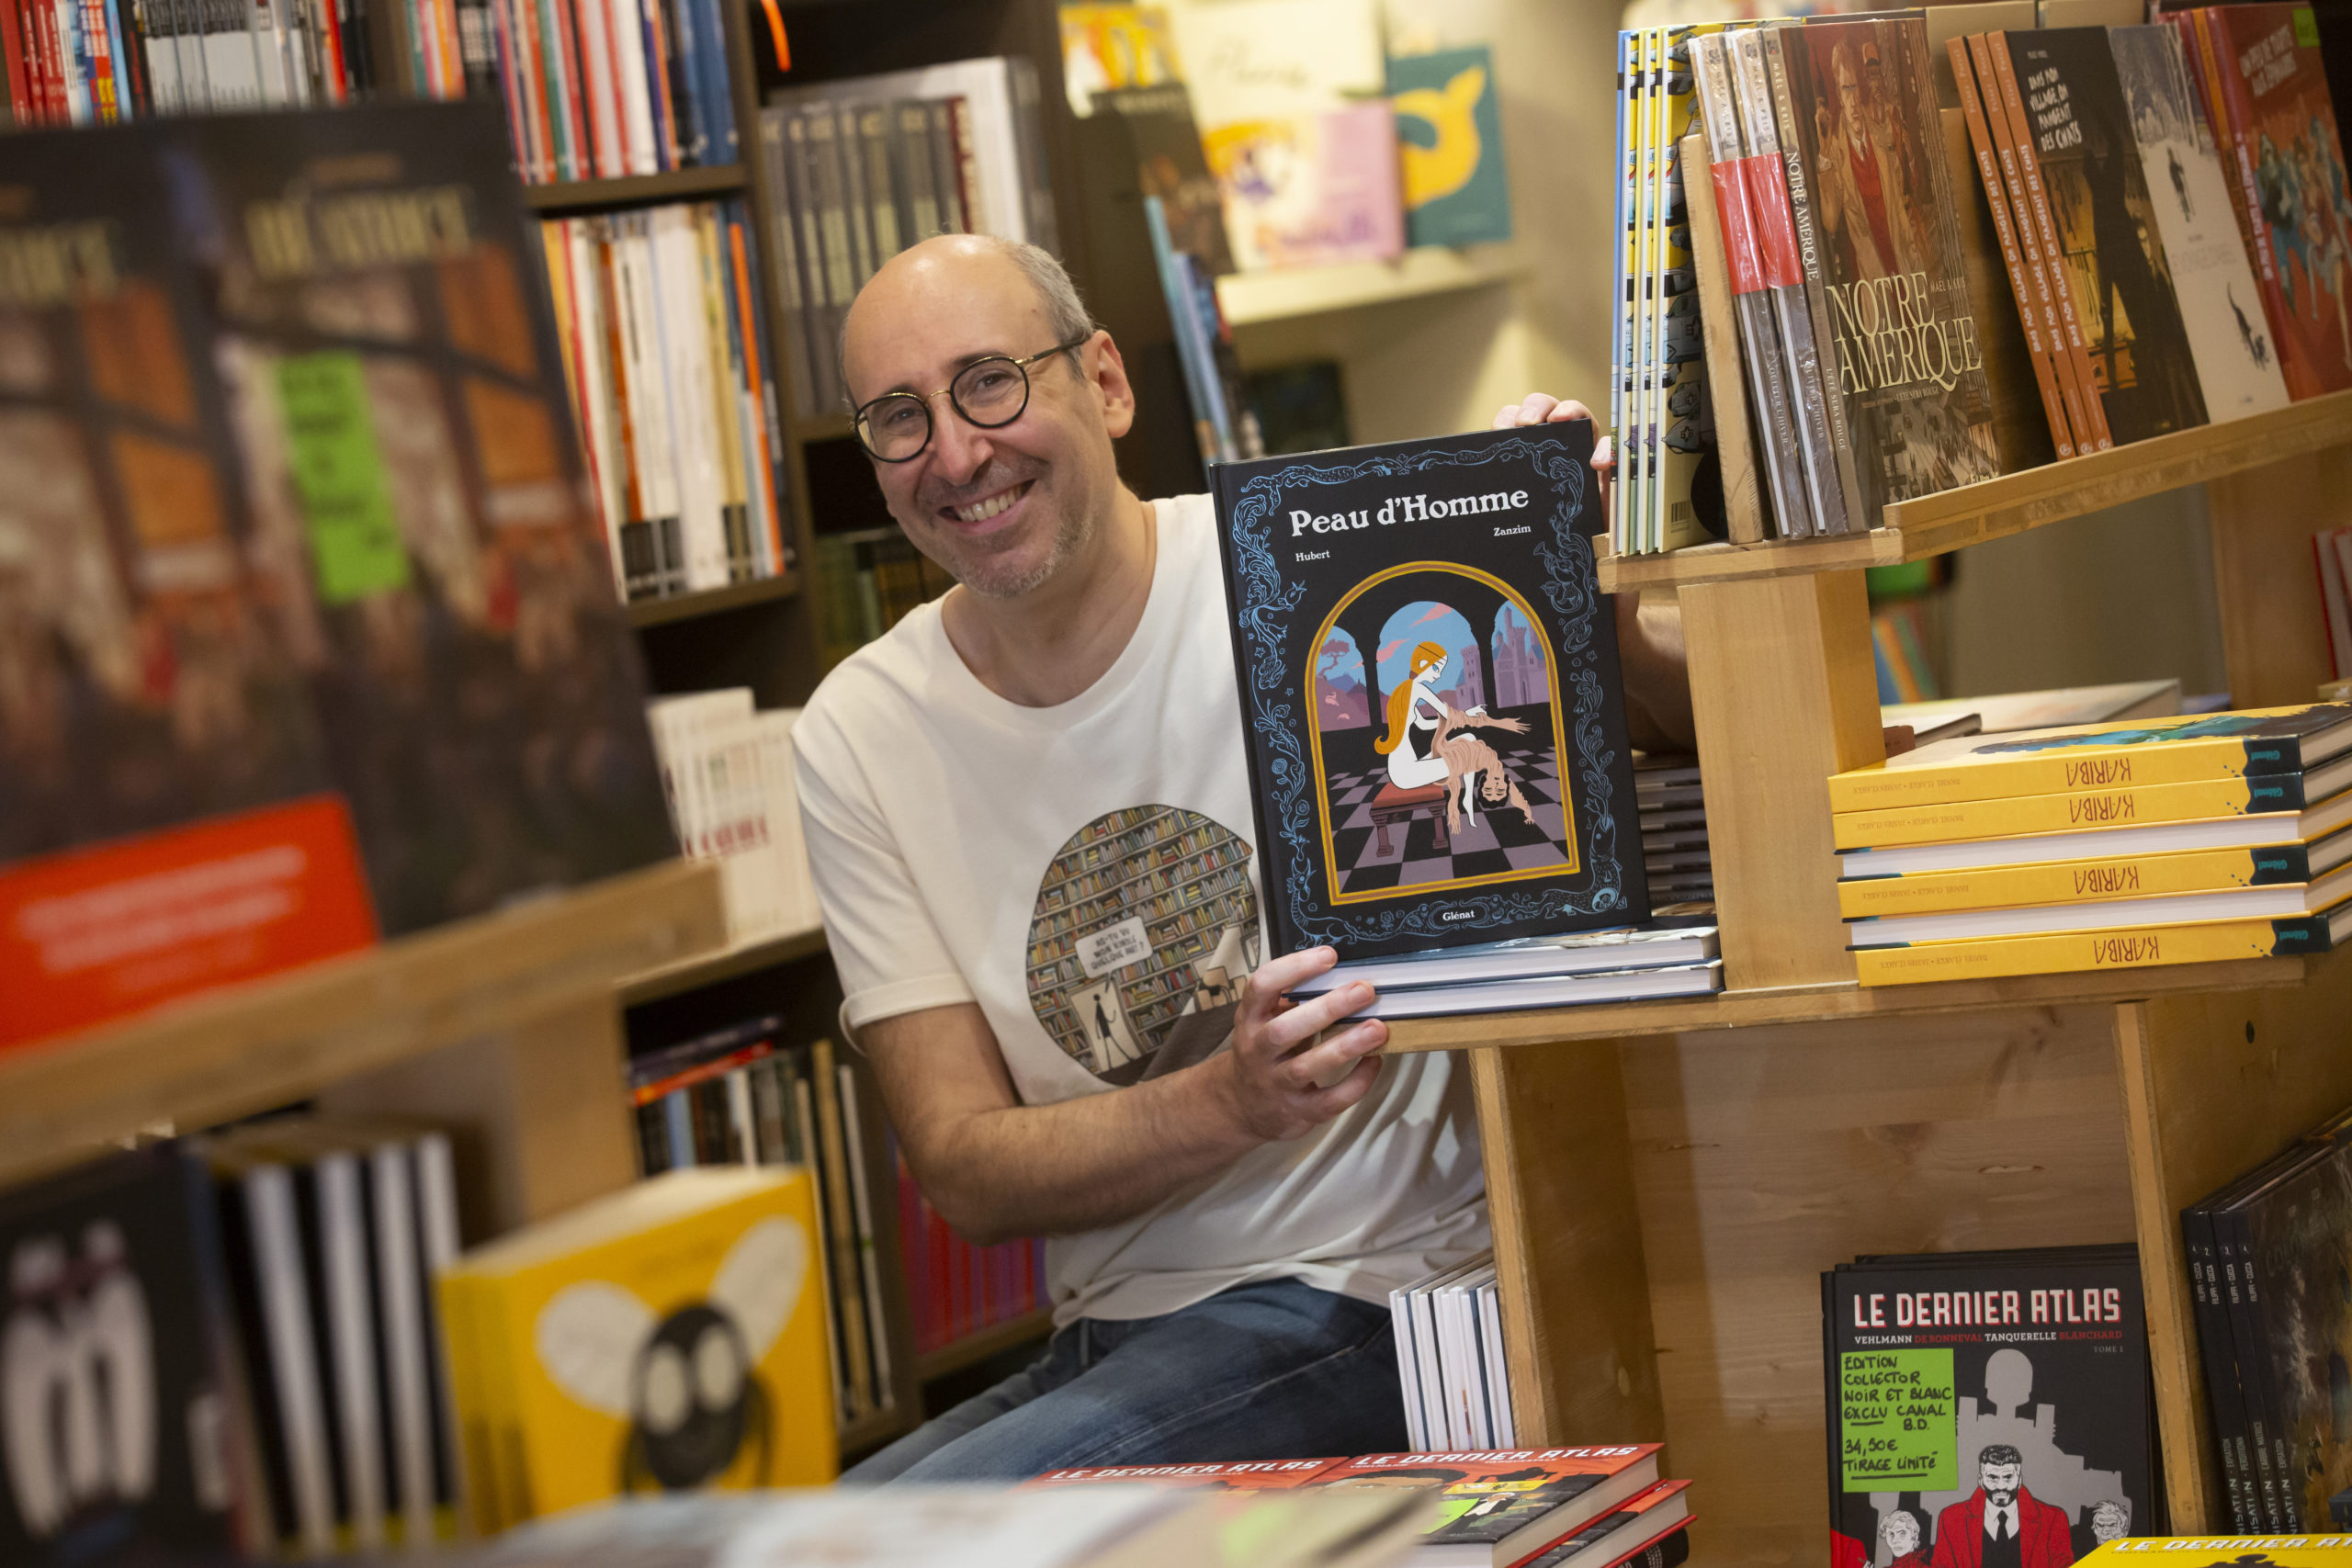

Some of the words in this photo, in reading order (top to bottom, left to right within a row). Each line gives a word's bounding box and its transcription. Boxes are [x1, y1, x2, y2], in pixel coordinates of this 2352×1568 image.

[2041, 131, 2054, 152] DES
[1980, 151, 1994, 177] CHATS
[2001, 149, 2015, 176] CHATS
[2020, 144, 2033, 172] CHATS
[1787, 152, 1806, 206] NOTRE
[2009, 178, 2021, 196] DES
[2028, 175, 2040, 191] DES
[1988, 181, 2000, 197] DES
[1825, 272, 1935, 343] NOTRE
[2029, 329, 2042, 353] DANS
[2050, 328, 2064, 352] DANS
[2068, 324, 2082, 347] DANS
[1830, 392, 1841, 417] SERA
[1836, 418, 1847, 450] ROUGE
[1289, 509, 1369, 536] Peau
[1376, 489, 1529, 525] d'Homme
[1493, 525, 1532, 536] Zanzim
[1295, 549, 1331, 563] Hubert
[2066, 758, 2132, 786] KARIBA
[2069, 794, 2135, 824] KARIBA
[2074, 865, 2140, 895] KARIBA
[1442, 908, 1476, 923] Glénat
[2094, 935, 2161, 964] KARIBA
[1854, 1293, 1887, 1327] LE
[1896, 1291, 2021, 1327] DERNIER
[2030, 1288, 2121, 1325] ATLAS
[1855, 1335, 1912, 1346] VEHLMANN
[1915, 1335, 1928, 1344] DE
[1929, 1333, 1983, 1344] BONNEVAL
[1984, 1332, 2057, 1343] TANQUERELLE
[2059, 1330, 2123, 1341] BLANCHARD
[2094, 1346, 2118, 1354] TOME
[1844, 1355, 1898, 1371] EDITION
[1844, 1371, 1921, 1386] COLLECTOR
[1844, 1388, 1881, 1403] NOIR
[1886, 1388, 1904, 1402] ET
[1910, 1387, 1952, 1401] BLANC
[1844, 1406, 1887, 1420] EXCLU
[1896, 1404, 1947, 1416] CANAL
[1904, 1418, 1930, 1431] B.D.
[1354, 1456, 1398, 1465] LE
[1399, 1451, 1535, 1465] DERNIER
[1541, 1446, 1639, 1459] ATLAS
[1845, 1438, 1898, 1457] 34,50€
[1051, 1470, 1092, 1479] LE
[1093, 1464, 1224, 1478] DERNIER
[1227, 1461, 1324, 1472] ATLAS
[1843, 1459, 1892, 1472] TIRAGE
[2114, 1540, 2157, 1551] LE
[2163, 1538, 2309, 1551] DERNIER
[2315, 1537, 2352, 1548] AT
